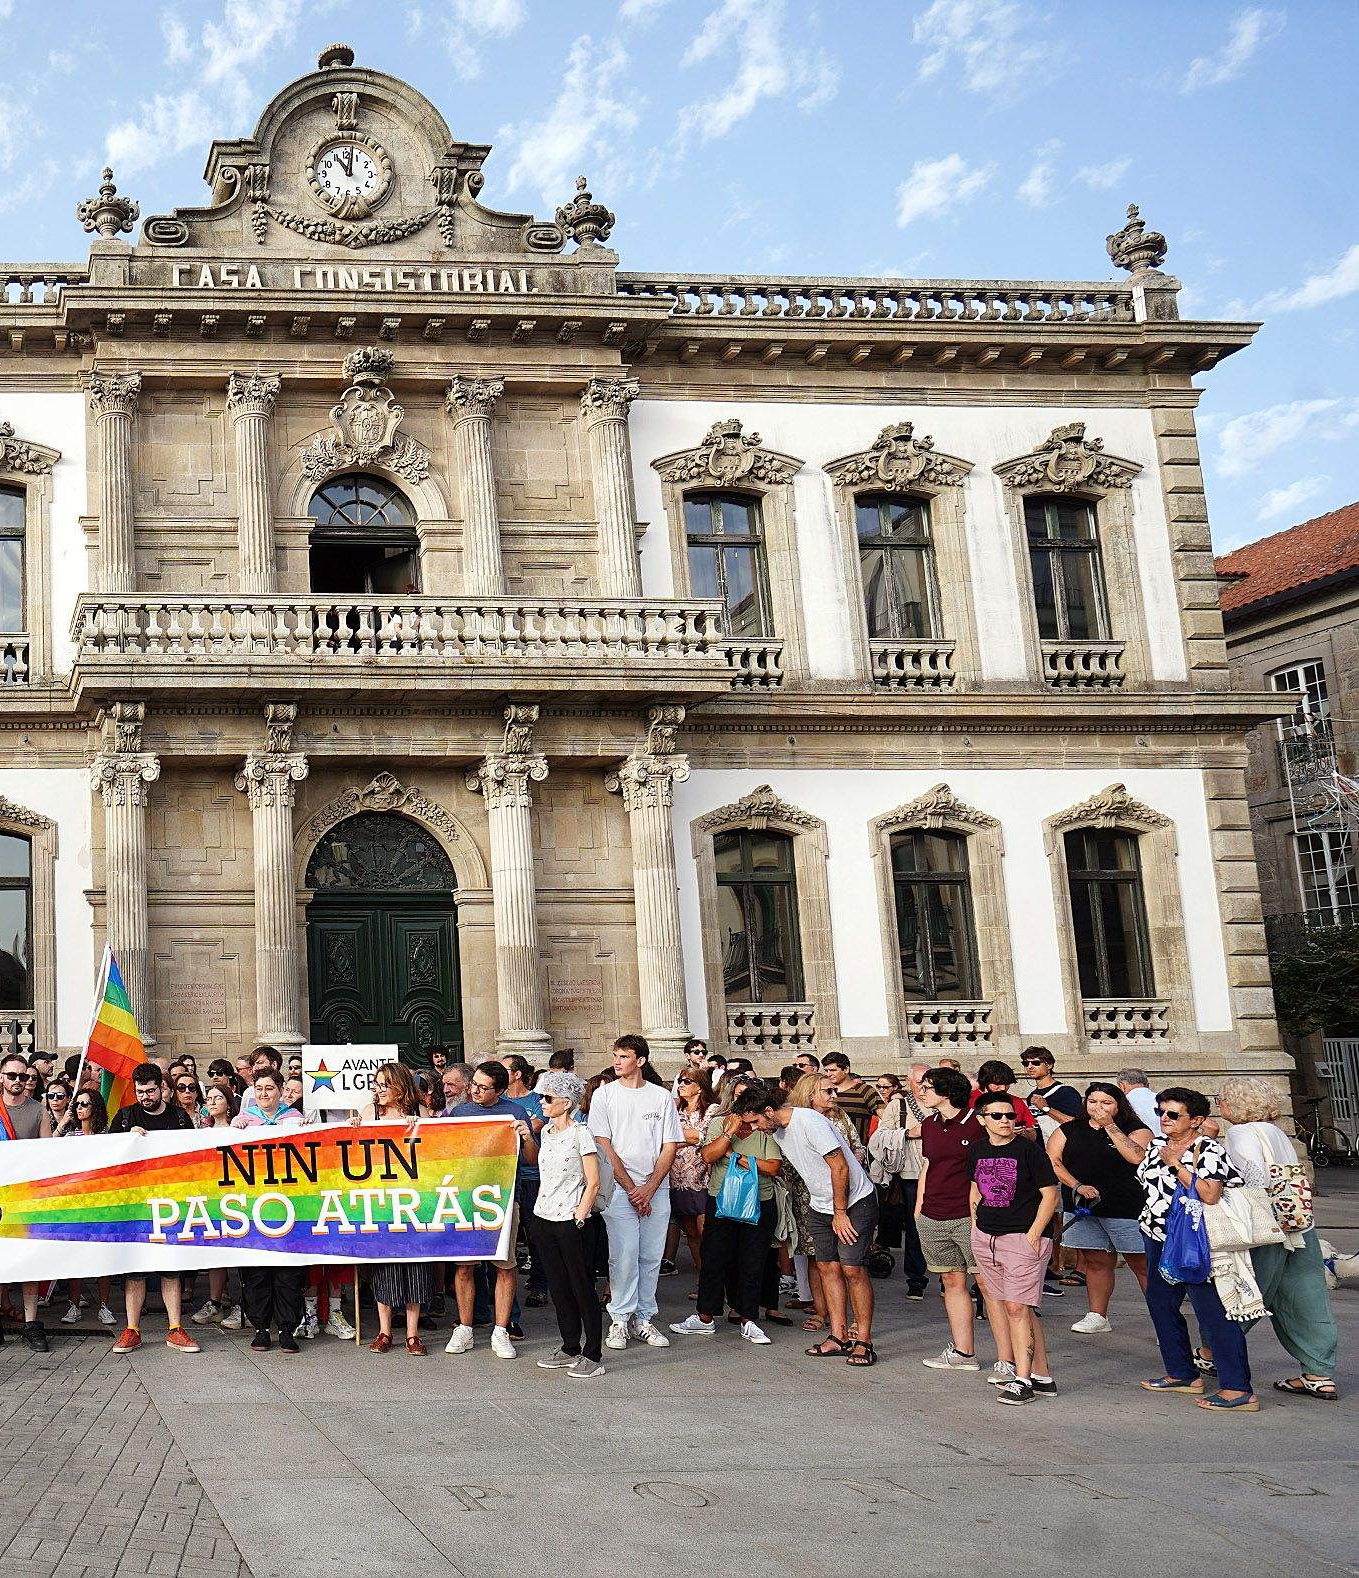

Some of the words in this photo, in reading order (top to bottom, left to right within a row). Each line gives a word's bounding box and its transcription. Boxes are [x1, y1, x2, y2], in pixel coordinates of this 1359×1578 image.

[324, 160, 332, 168] 10
[322, 170, 327, 178] 9
[325, 180, 330, 188] 8
[335, 187, 340, 195] 7
[355, 187, 361, 195] 5
[172, 263, 263, 289] CASA
[293, 265, 539, 293] CONSISTORIAL
[342, 1058, 394, 1071] AVAN
[216, 1142, 322, 1187] NIN
[336, 1138, 422, 1182] UN
[146, 1193, 297, 1243] PASO
[311, 1175, 505, 1236] ATRÁS
